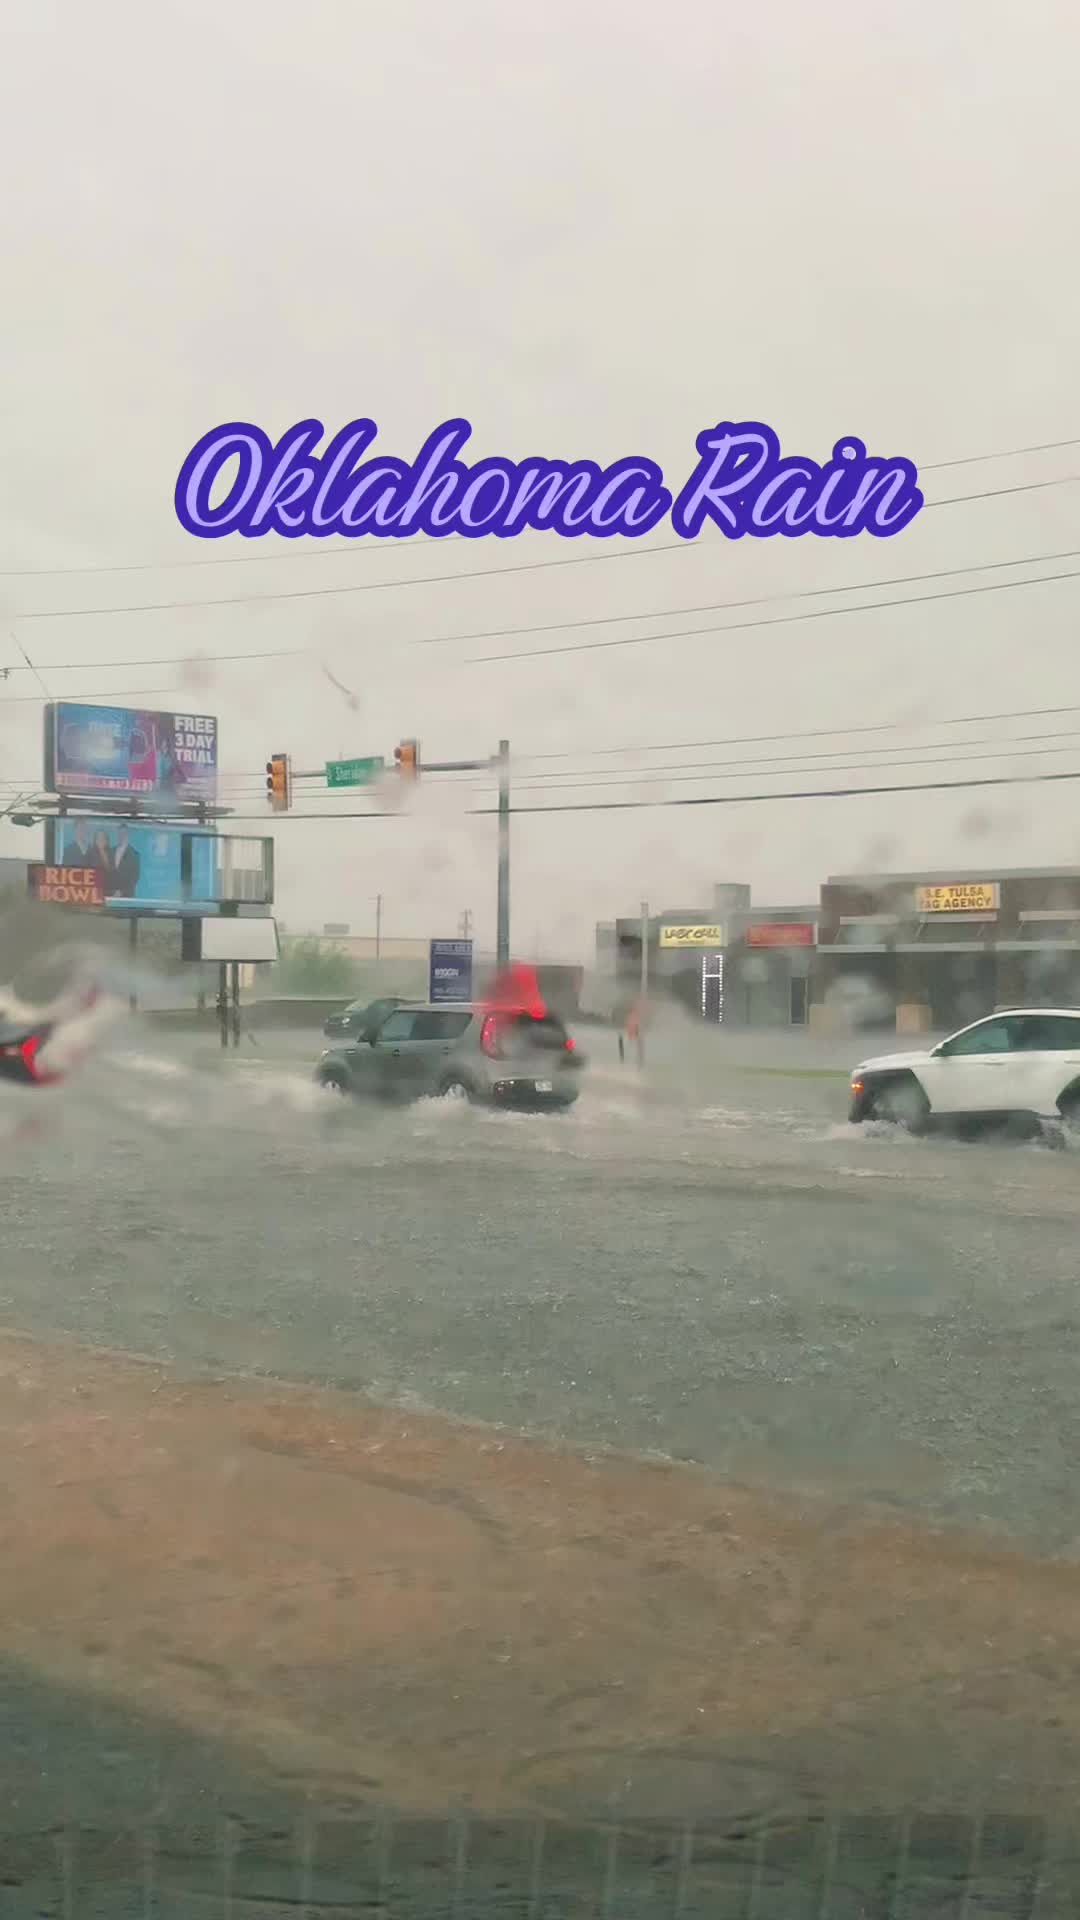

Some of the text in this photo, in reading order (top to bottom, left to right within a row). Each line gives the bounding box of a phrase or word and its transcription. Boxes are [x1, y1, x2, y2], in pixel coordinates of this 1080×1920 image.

[174, 715, 215, 733] FREE
[175, 734, 214, 749] 3 DAY
[175, 749, 214, 764] TRIAL
[45, 867, 96, 885] RICE
[39, 885, 104, 904] BOWL
[948, 886, 984, 897] TULSA
[944, 897, 992, 908] AGENCY
